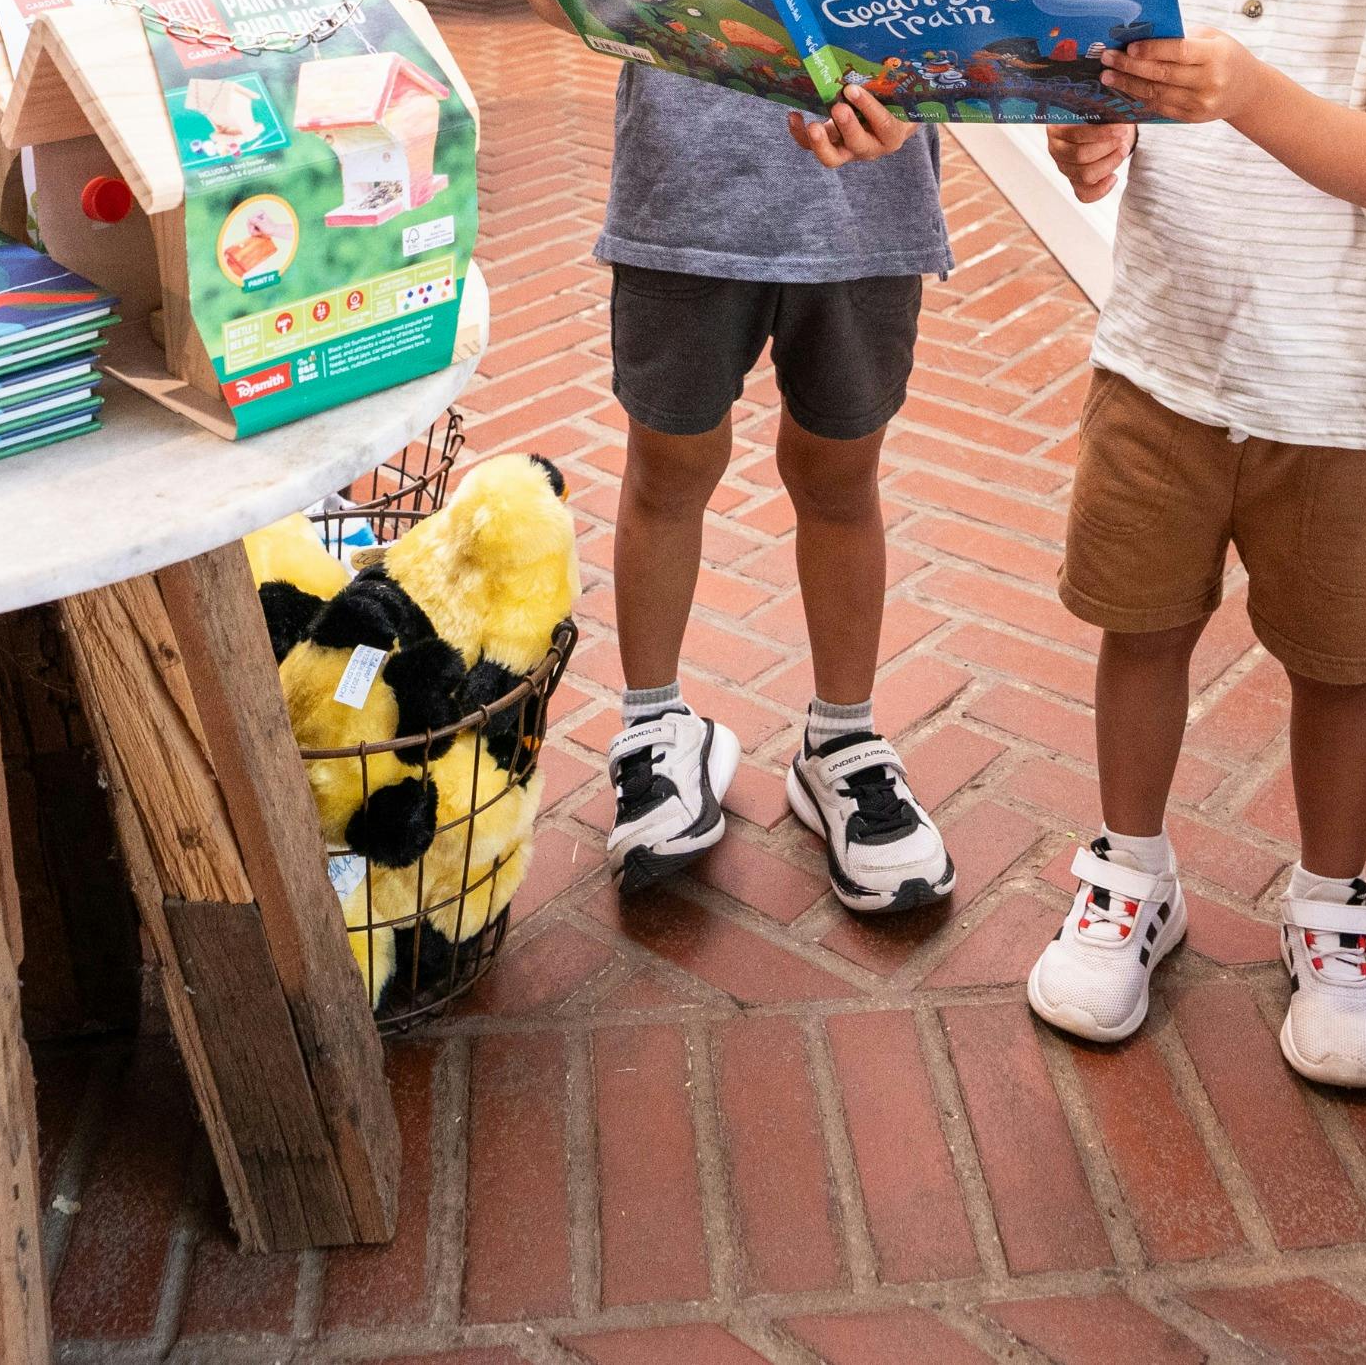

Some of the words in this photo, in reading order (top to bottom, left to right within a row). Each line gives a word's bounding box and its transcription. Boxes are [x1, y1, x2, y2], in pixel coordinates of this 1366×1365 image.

[235, 11, 290, 44] BIRD
[874, 4, 995, 40] Train
[188, 46, 230, 60] GARDEN
[236, 372, 285, 398] Toysmith
[828, 753, 861, 772] UNDER
